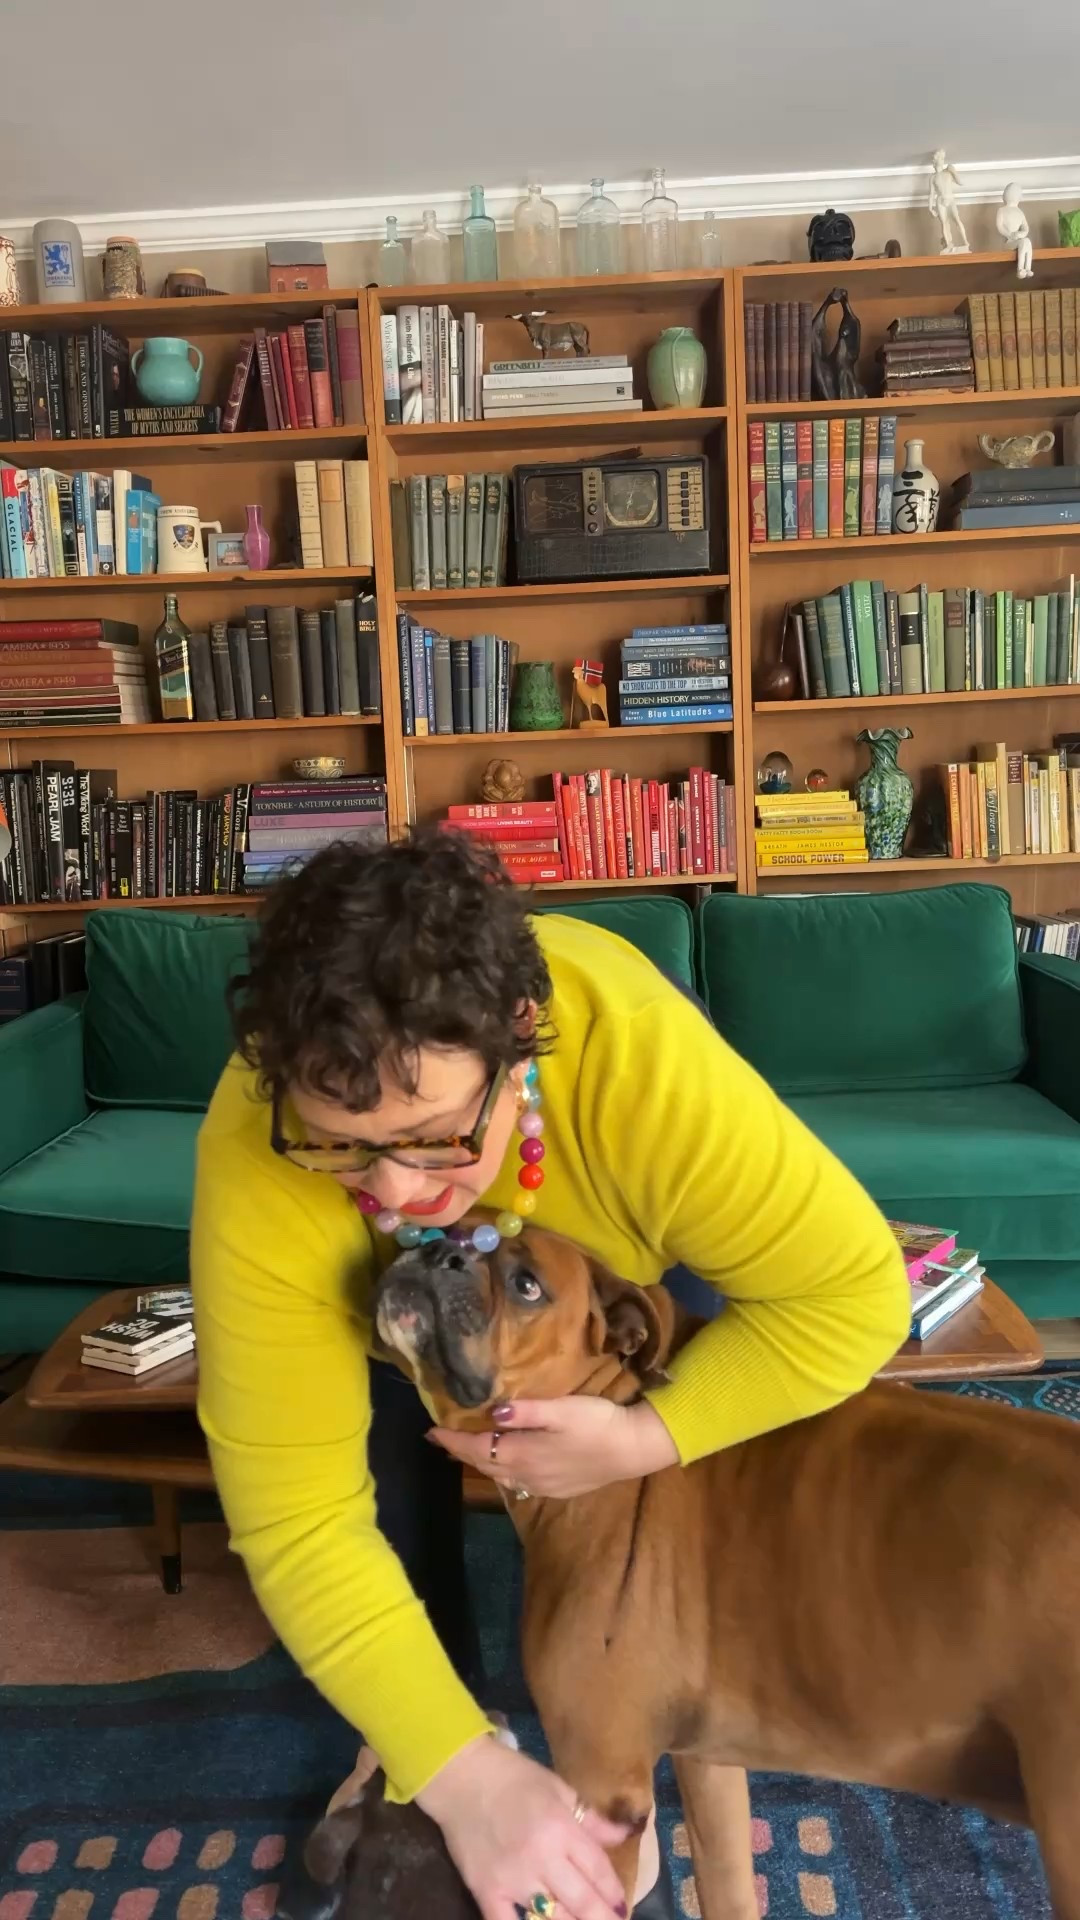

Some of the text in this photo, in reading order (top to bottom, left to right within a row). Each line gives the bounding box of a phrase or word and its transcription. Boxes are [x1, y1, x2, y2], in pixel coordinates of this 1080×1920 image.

[385, 319, 394, 370] Windswept
[406, 334, 414, 362] Richards
[493, 362, 541, 372] GREENBELT
[110, 410, 119, 435] WALKER
[124, 405, 204, 421] THE WOMEN'S ENCYCLOPEDIA
[132, 420, 198, 434] OF MYTHS AND SECRETS
[7, 503, 17, 553] GLACIAL
[863, 595, 871, 619] ZELDA
[48, 641, 70, 650] 1955
[0, 675, 76, 688] CAMERA 1949
[622, 680, 688, 691] NO SHORTCUTS TO THE TOP
[623, 697, 655, 706] HIDDEN
[656, 695, 690, 704] HISTORY
[647, 707, 712, 718] Blue Latitudes
[62, 776, 75, 807] 9:30
[47, 776, 61, 842] PEARL JAM
[80, 776, 90, 836] The Viking World
[223, 793, 231, 814] WEIRD
[256, 802, 294, 811] TOYNBEE
[306, 799, 331, 808] STUDY
[331, 799, 342, 807] OF
[343, 797, 378, 806] HISTORY
[986, 786, 998, 834] Mayflower
[234, 798, 248, 831] Victors
[253, 816, 286, 827] LUXE
[222, 815, 231, 846] MARYLAND
[613, 791, 625, 867] HOW TO BE OLD
[651, 813, 660, 868] RISING TROUBLEMAKER
[511, 855, 548, 864] THE AGES
[771, 853, 845, 865] SCHOOL POWER
[101, 1323, 155, 1339] WASH
